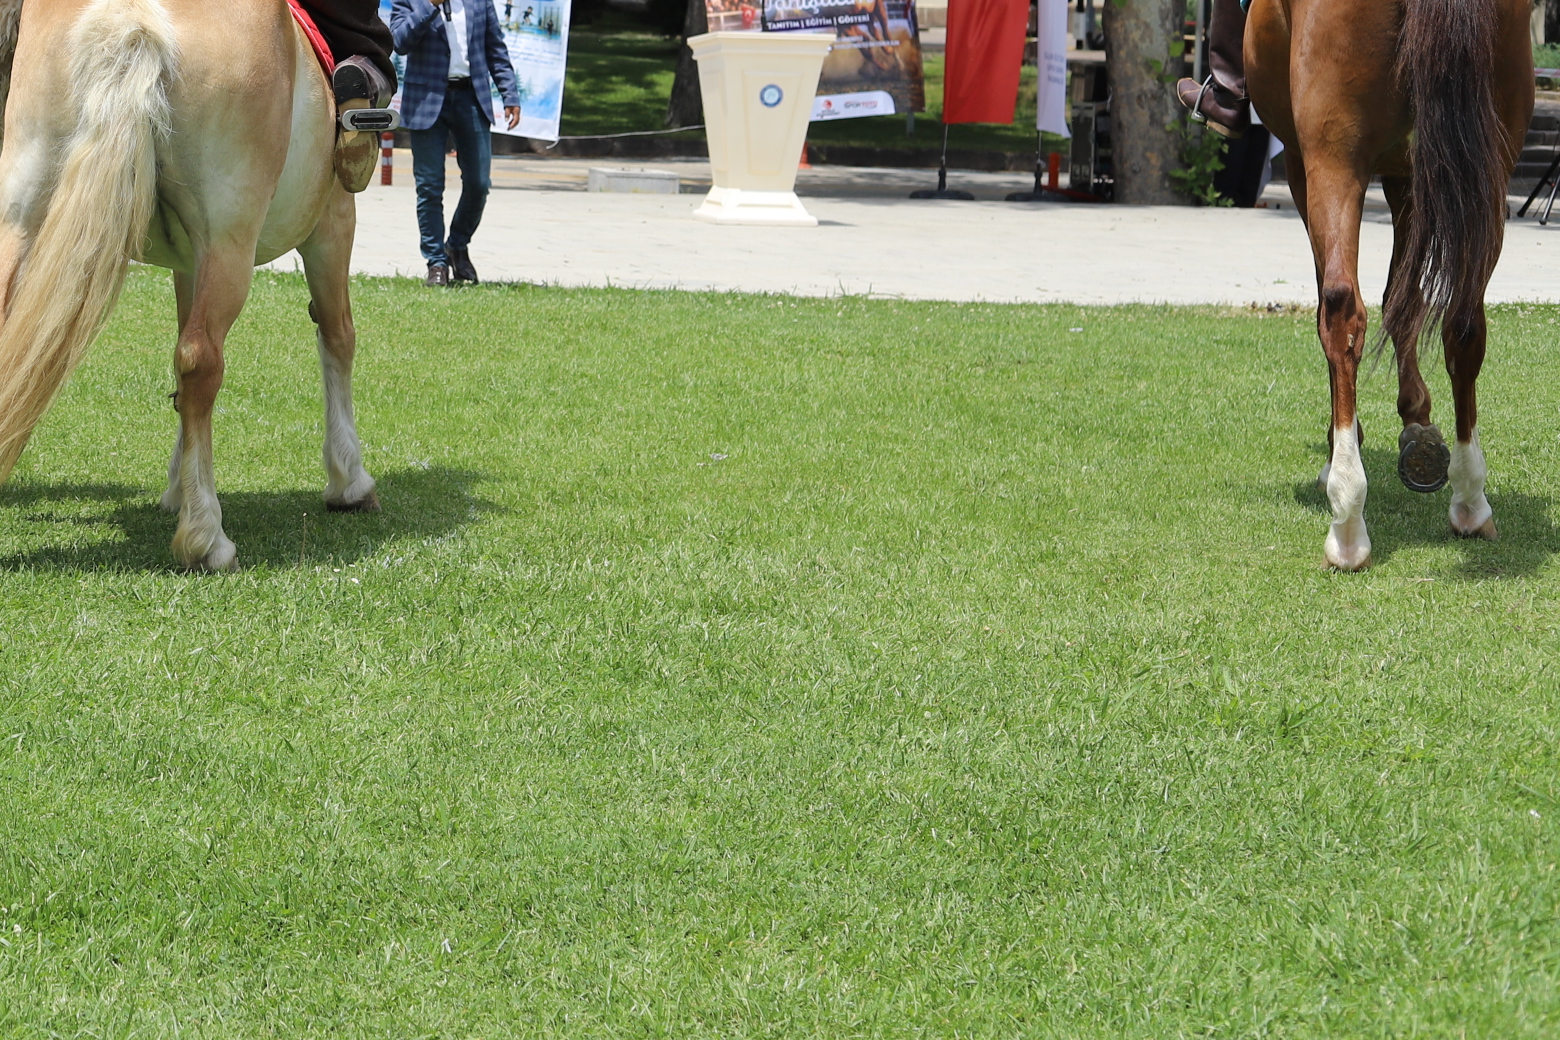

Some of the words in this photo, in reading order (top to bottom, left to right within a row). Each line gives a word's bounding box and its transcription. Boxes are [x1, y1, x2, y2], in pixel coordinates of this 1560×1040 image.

[767, 20, 800, 31] TANITIM
[805, 16, 833, 27] EĞİTİM
[838, 14, 870, 25] GÖSTERİ
